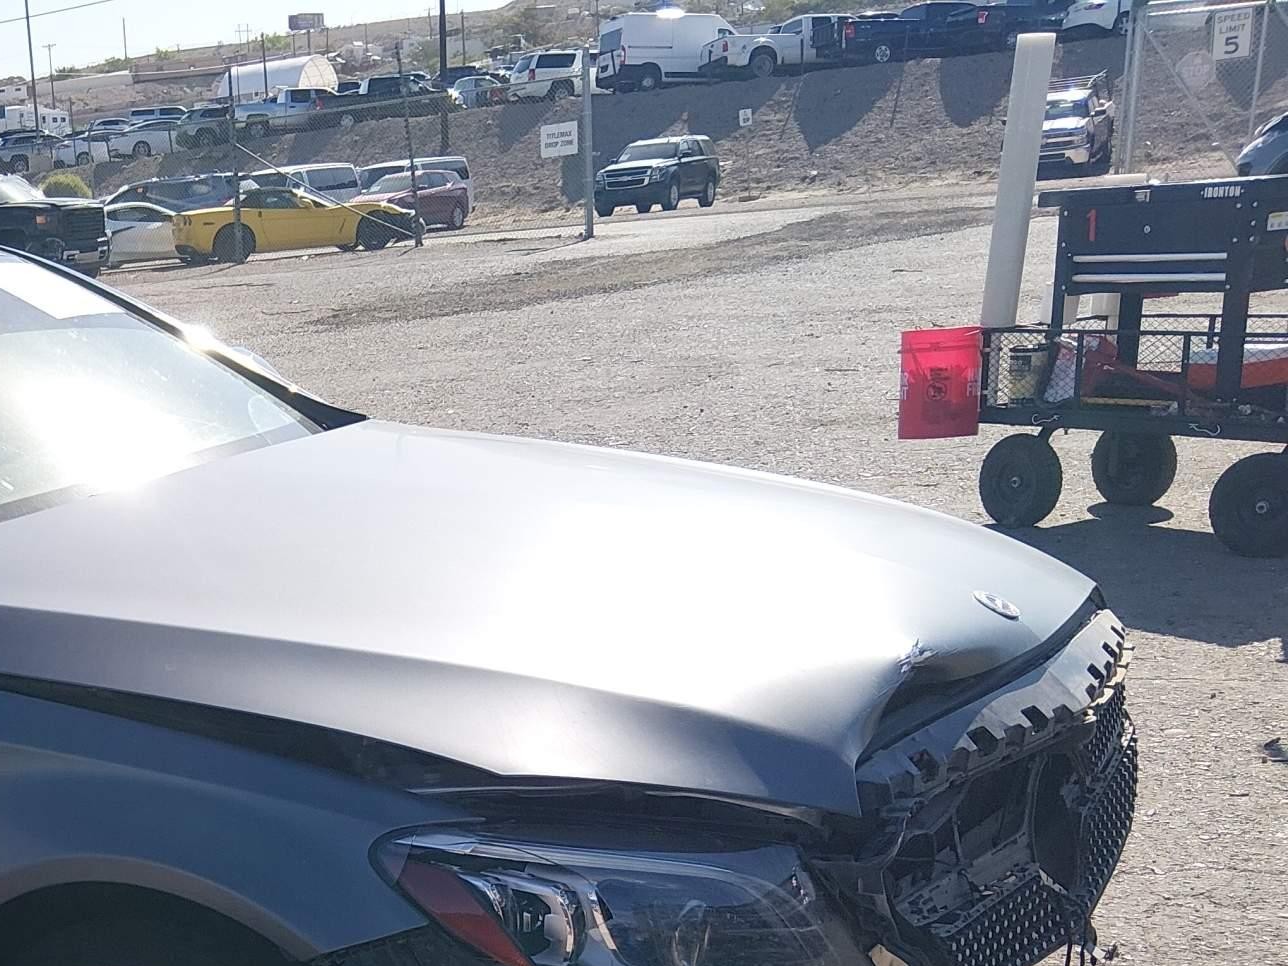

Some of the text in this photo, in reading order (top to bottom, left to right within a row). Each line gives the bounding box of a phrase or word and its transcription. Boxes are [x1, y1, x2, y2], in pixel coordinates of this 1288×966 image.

[1216, 13, 1249, 24] SPEED
[1219, 24, 1245, 34] LIMIT
[1224, 36, 1239, 54] 5
[1086, 208, 1098, 242] 1
